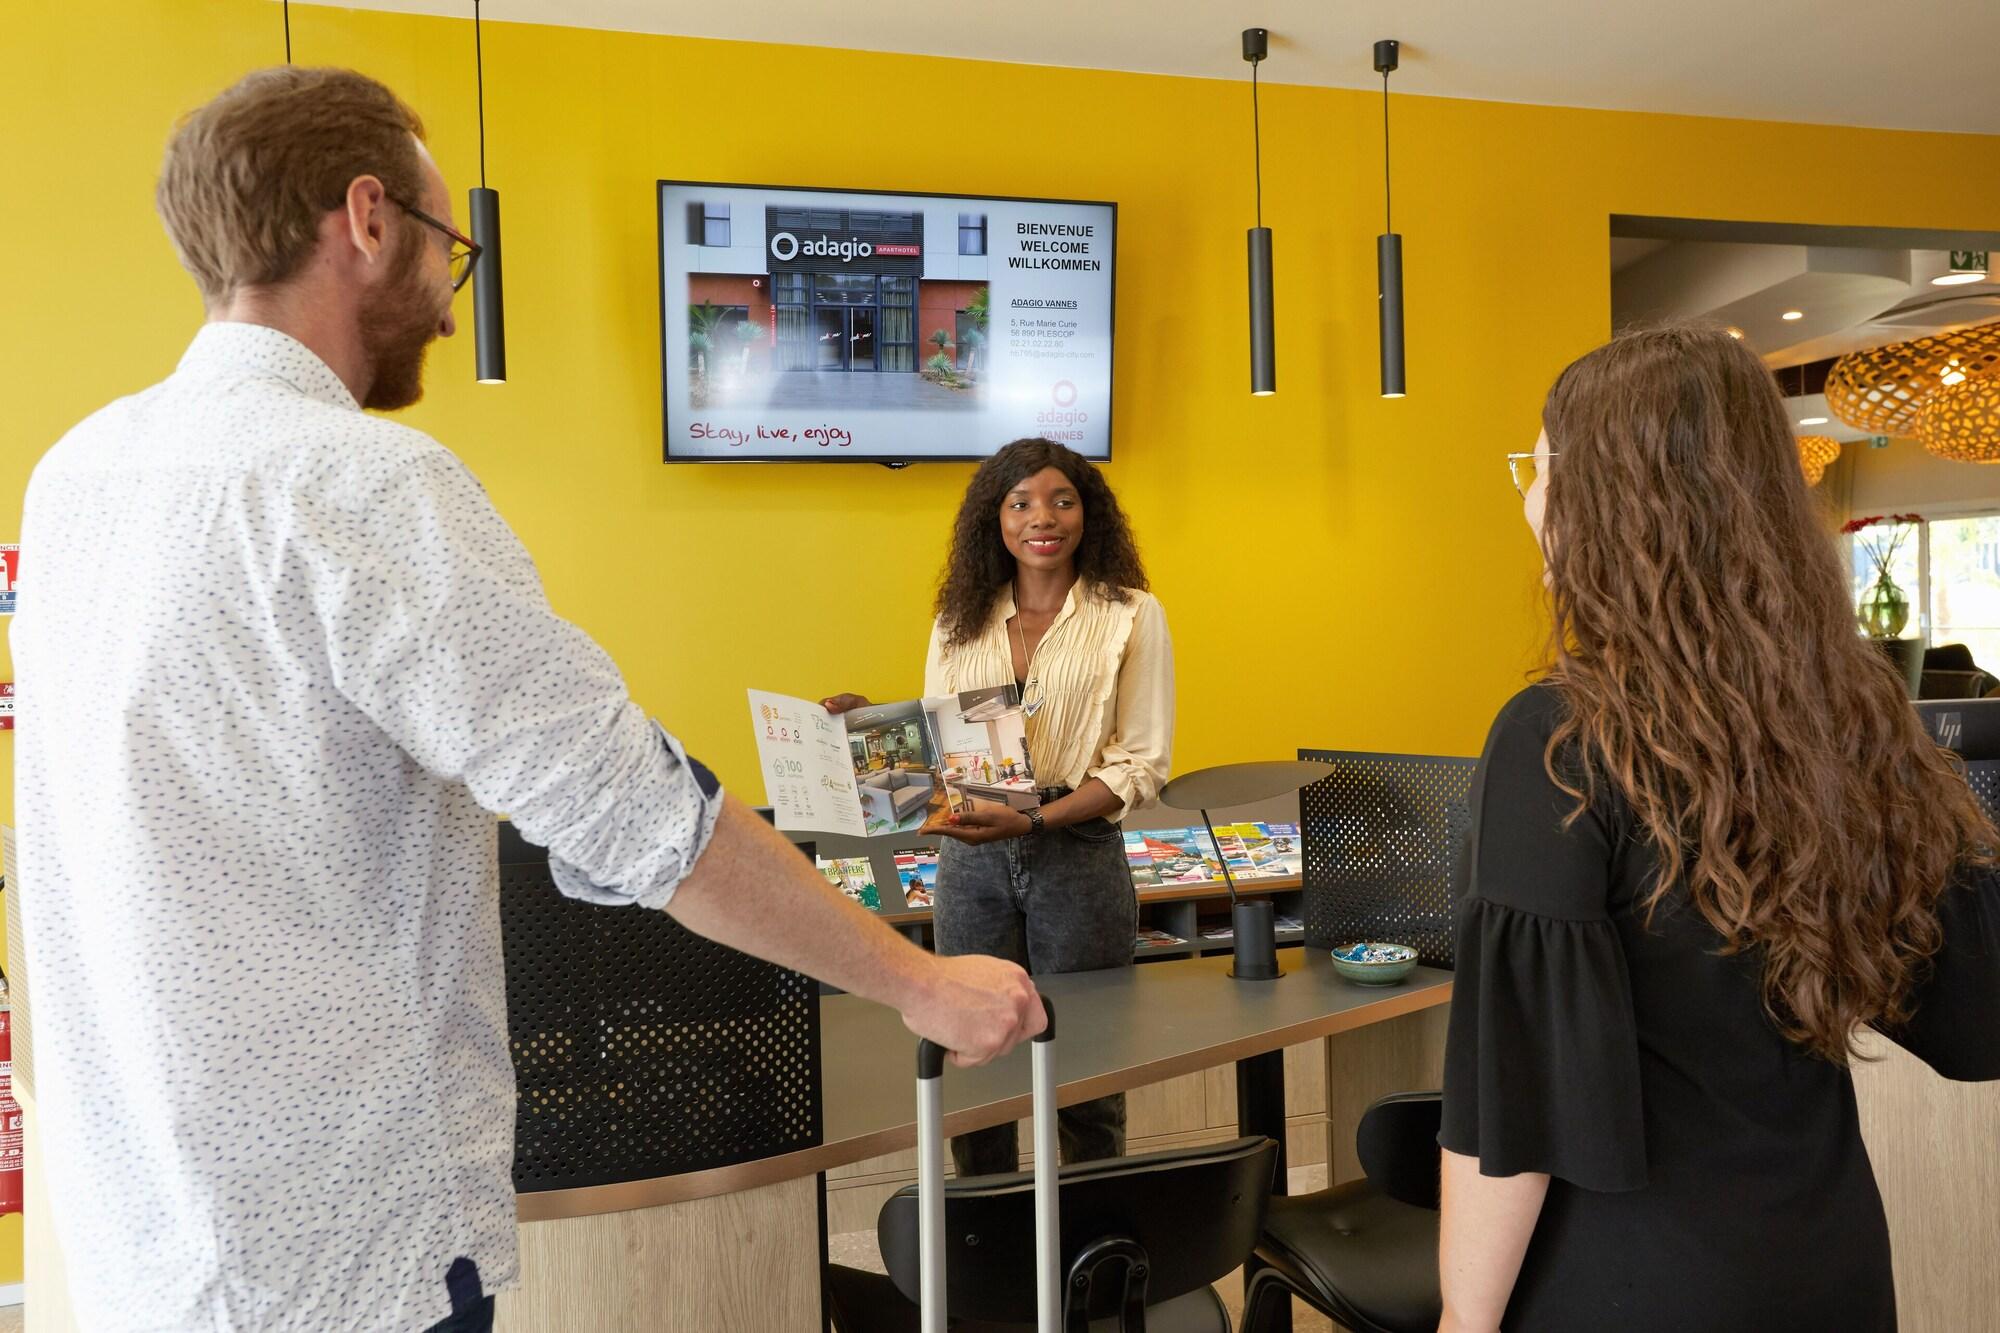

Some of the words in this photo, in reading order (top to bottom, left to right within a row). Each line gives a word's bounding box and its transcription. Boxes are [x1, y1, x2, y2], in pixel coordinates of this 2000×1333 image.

[1016, 222, 1094, 238] BIENVENUE
[802, 233, 872, 263] adagio
[878, 246, 917, 254] APARTHOTEL
[1020, 239, 1090, 255] WELCOME
[1008, 256, 1101, 272] WILLKOMMEN
[1010, 298, 1043, 308] ADAGIO
[1045, 299, 1078, 309] VANNES
[1019, 319, 1035, 328] Rue
[1036, 320, 1057, 328] Marie
[1058, 320, 1078, 329] Curie
[1037, 330, 1075, 339] PLESCOP
[1036, 408, 1088, 428] adagio
[689, 422, 750, 447] Stay,
[756, 425, 798, 443] live,
[804, 423, 852, 447] enjoy
[1040, 430, 1084, 441] VANNES
[1939, 712, 1961, 748] hp
